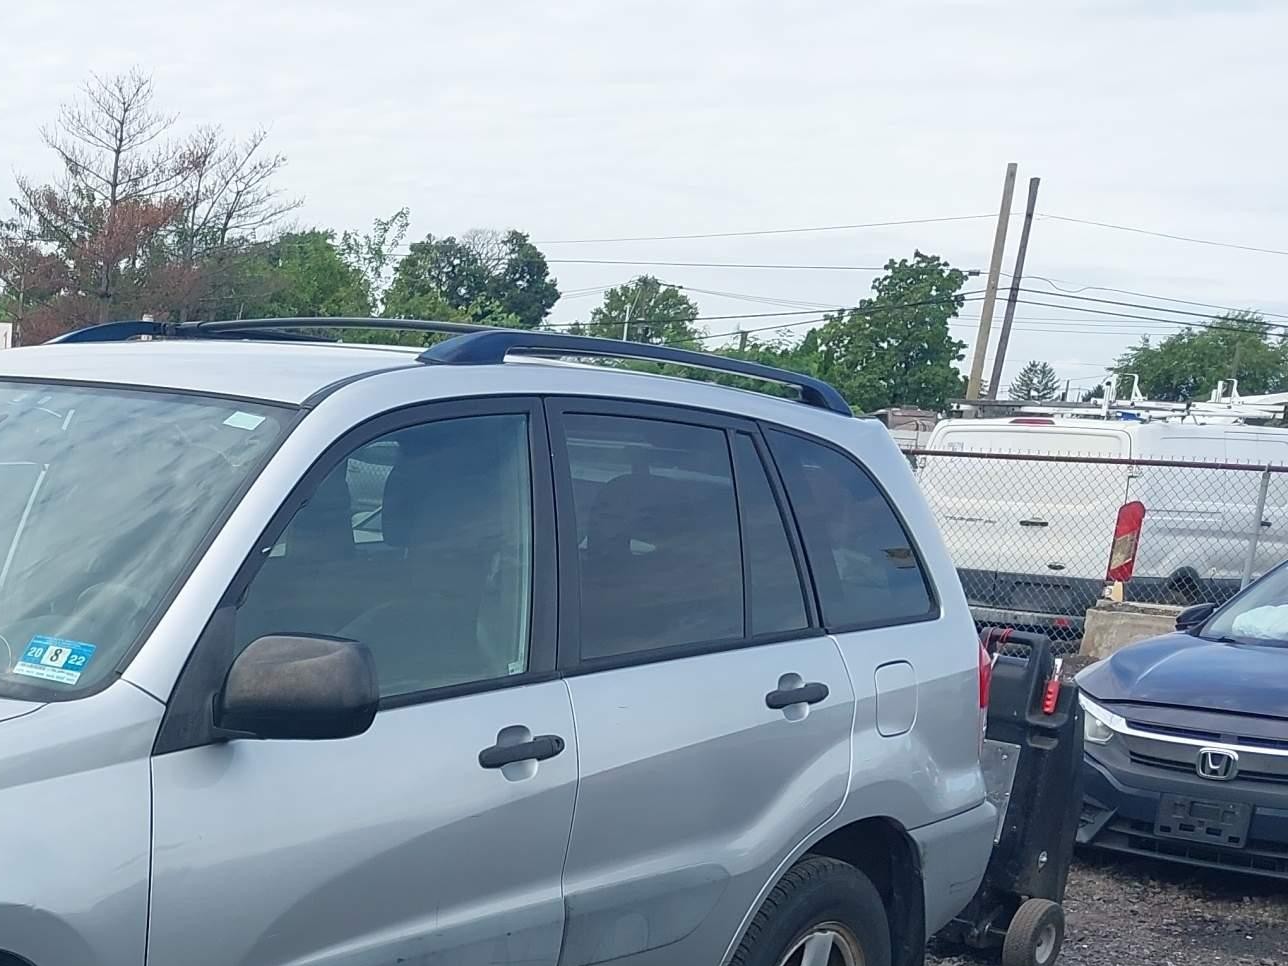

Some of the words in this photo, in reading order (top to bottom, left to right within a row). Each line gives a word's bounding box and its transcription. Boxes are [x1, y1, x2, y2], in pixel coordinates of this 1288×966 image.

[27, 646, 43, 658] 20
[49, 648, 62, 662] 8
[67, 654, 86, 666] 22
